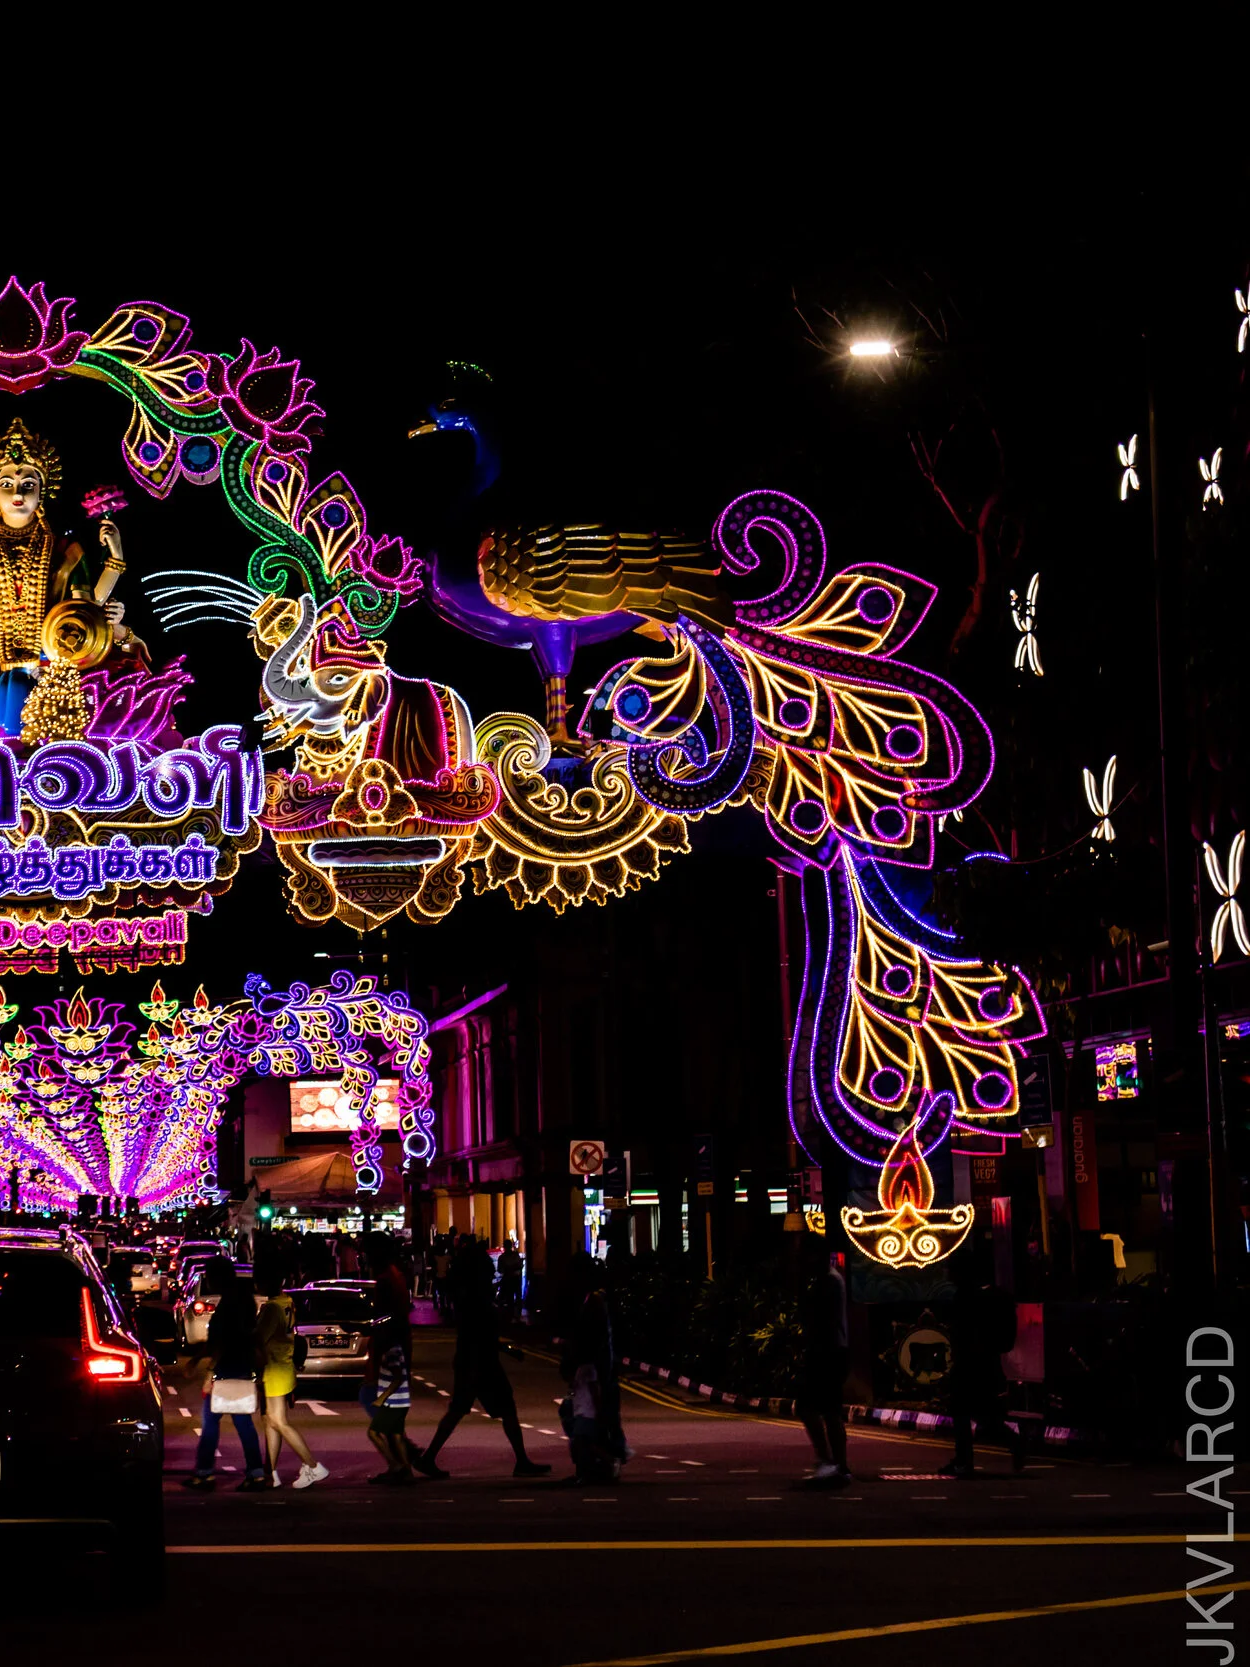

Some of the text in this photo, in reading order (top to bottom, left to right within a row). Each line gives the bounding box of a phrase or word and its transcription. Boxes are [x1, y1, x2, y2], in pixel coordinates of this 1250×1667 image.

[1072, 1116, 1089, 1184] guardian
[973, 1159, 996, 1170] FRESH
[974, 1168, 996, 1180] VEG?
